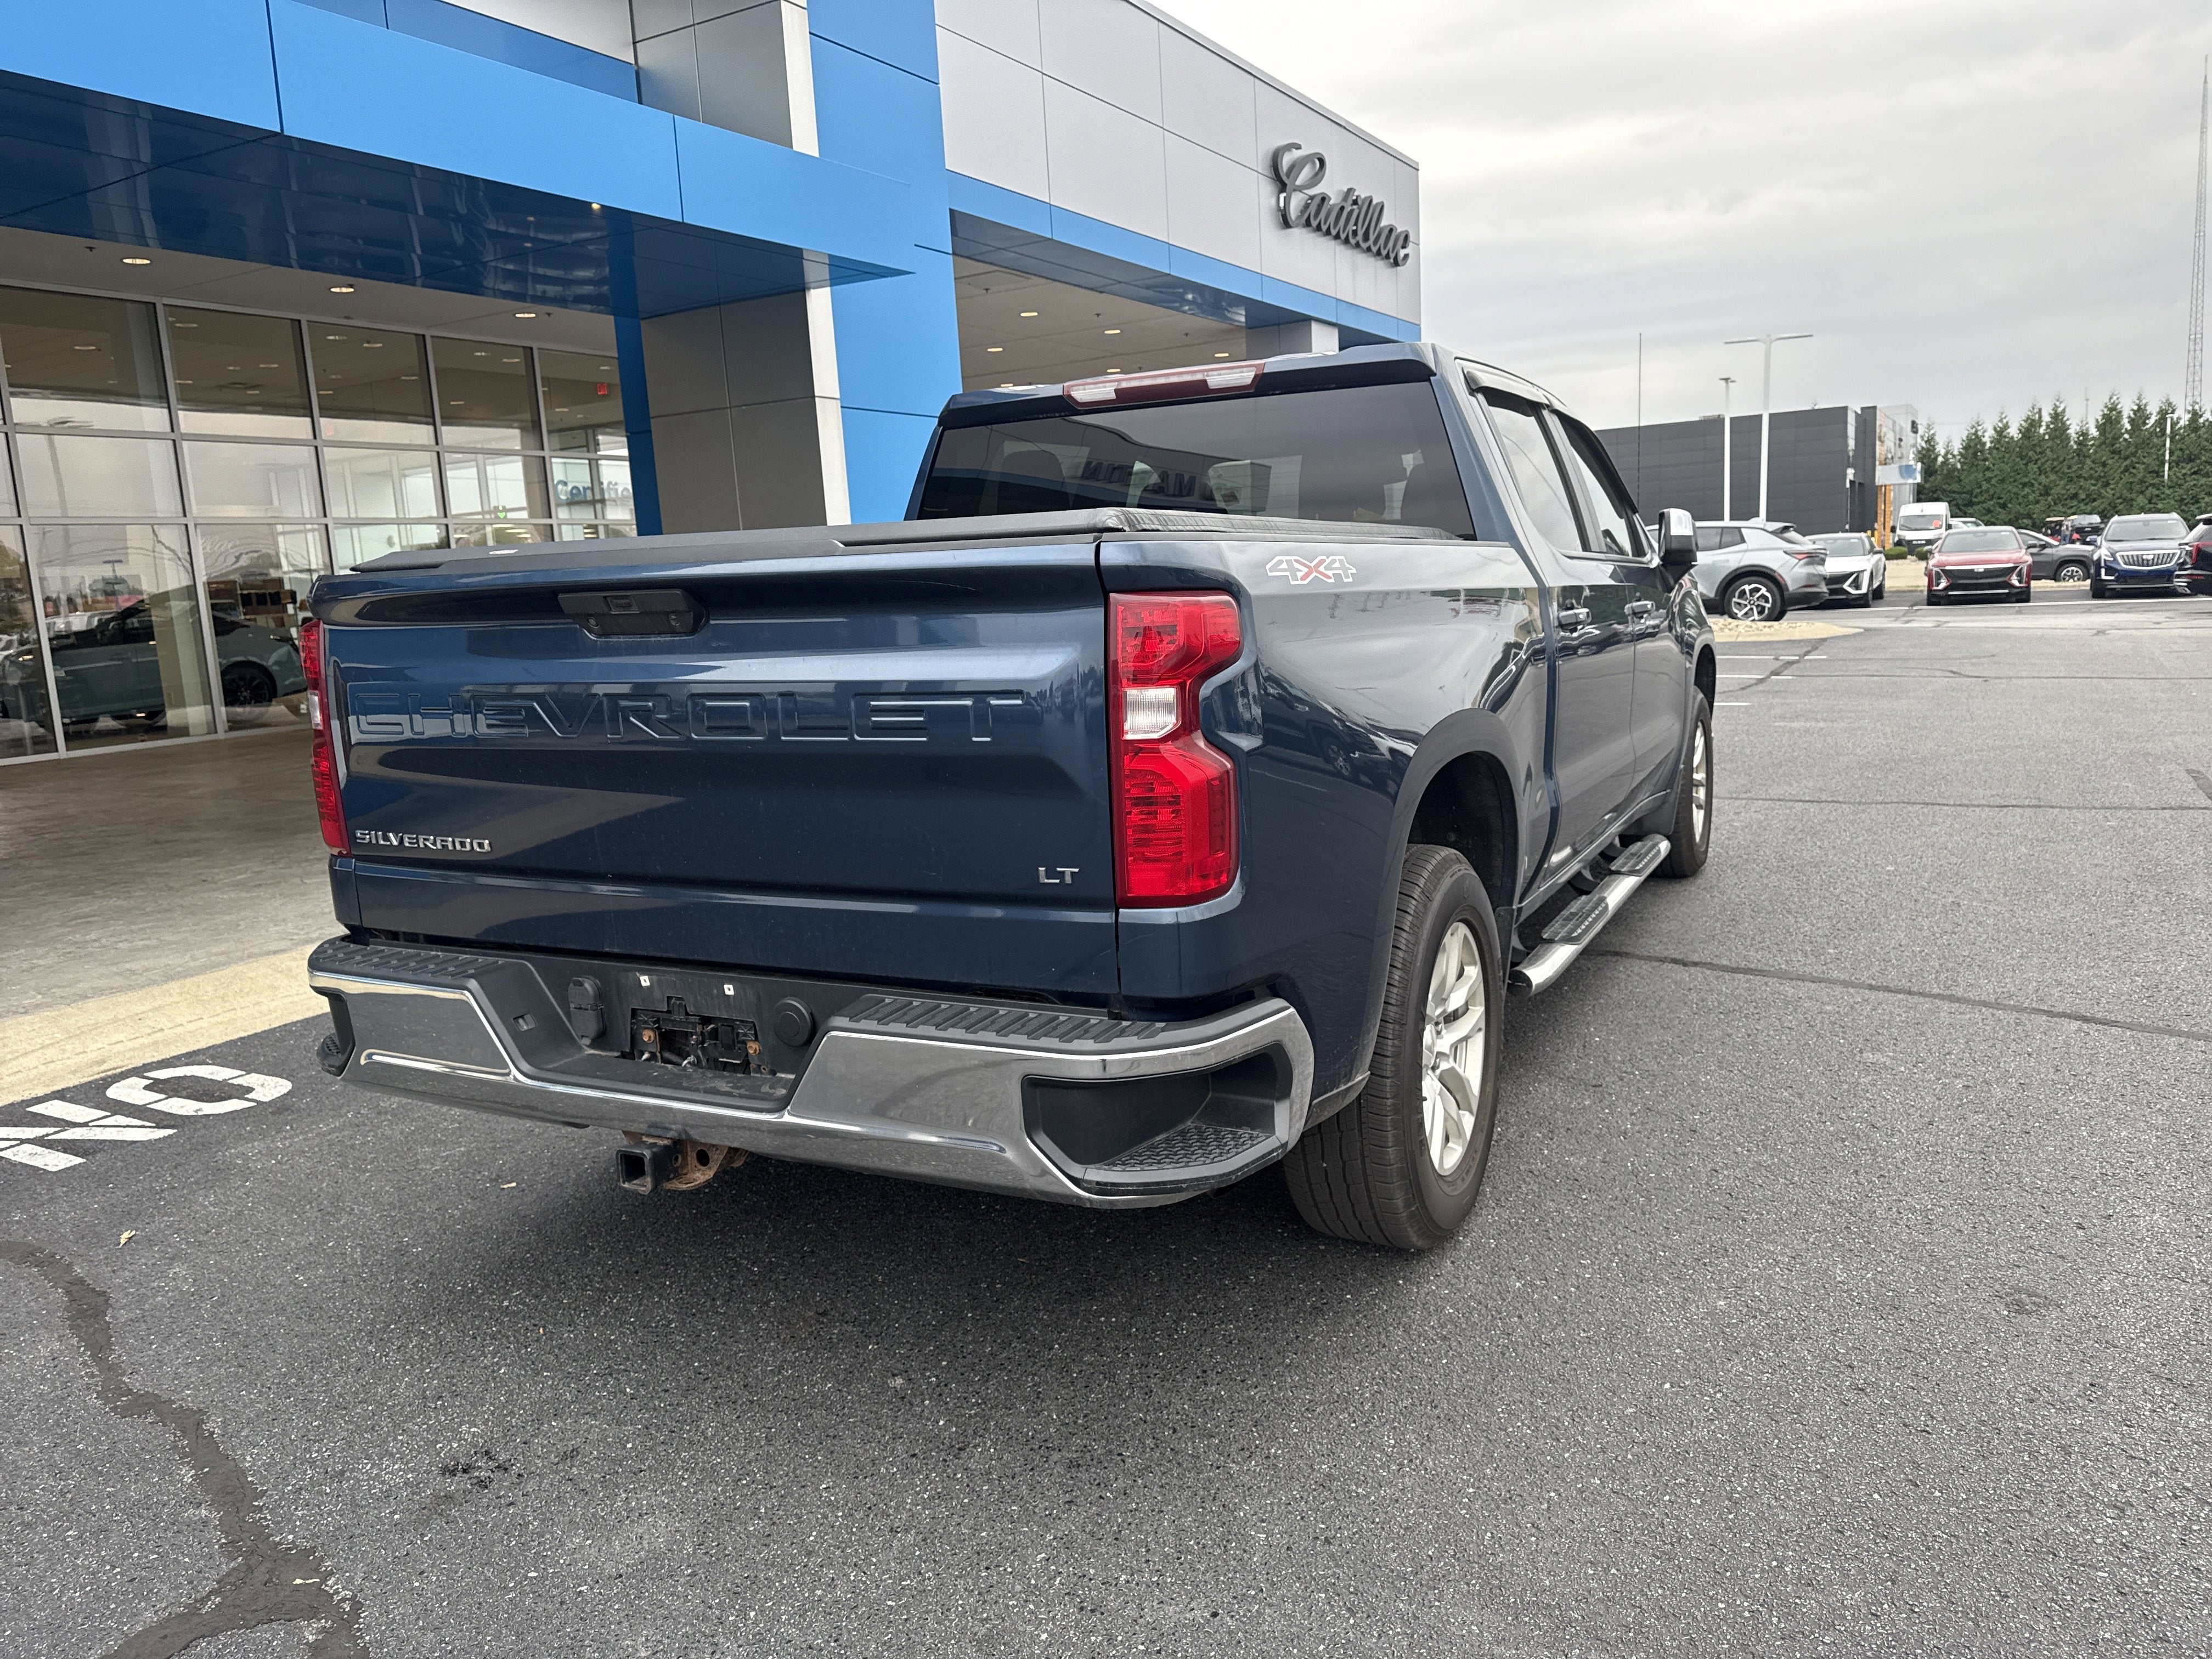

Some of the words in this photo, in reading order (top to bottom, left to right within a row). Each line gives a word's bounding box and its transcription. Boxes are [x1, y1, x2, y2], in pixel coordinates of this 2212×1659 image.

[1272, 142, 1410, 267] Cadillac
[356, 690, 1026, 741] CHEVROLET
[356, 830, 491, 853] SILVERADO
[1039, 867, 1080, 884] LT
[0, 1065, 293, 1172] NO
